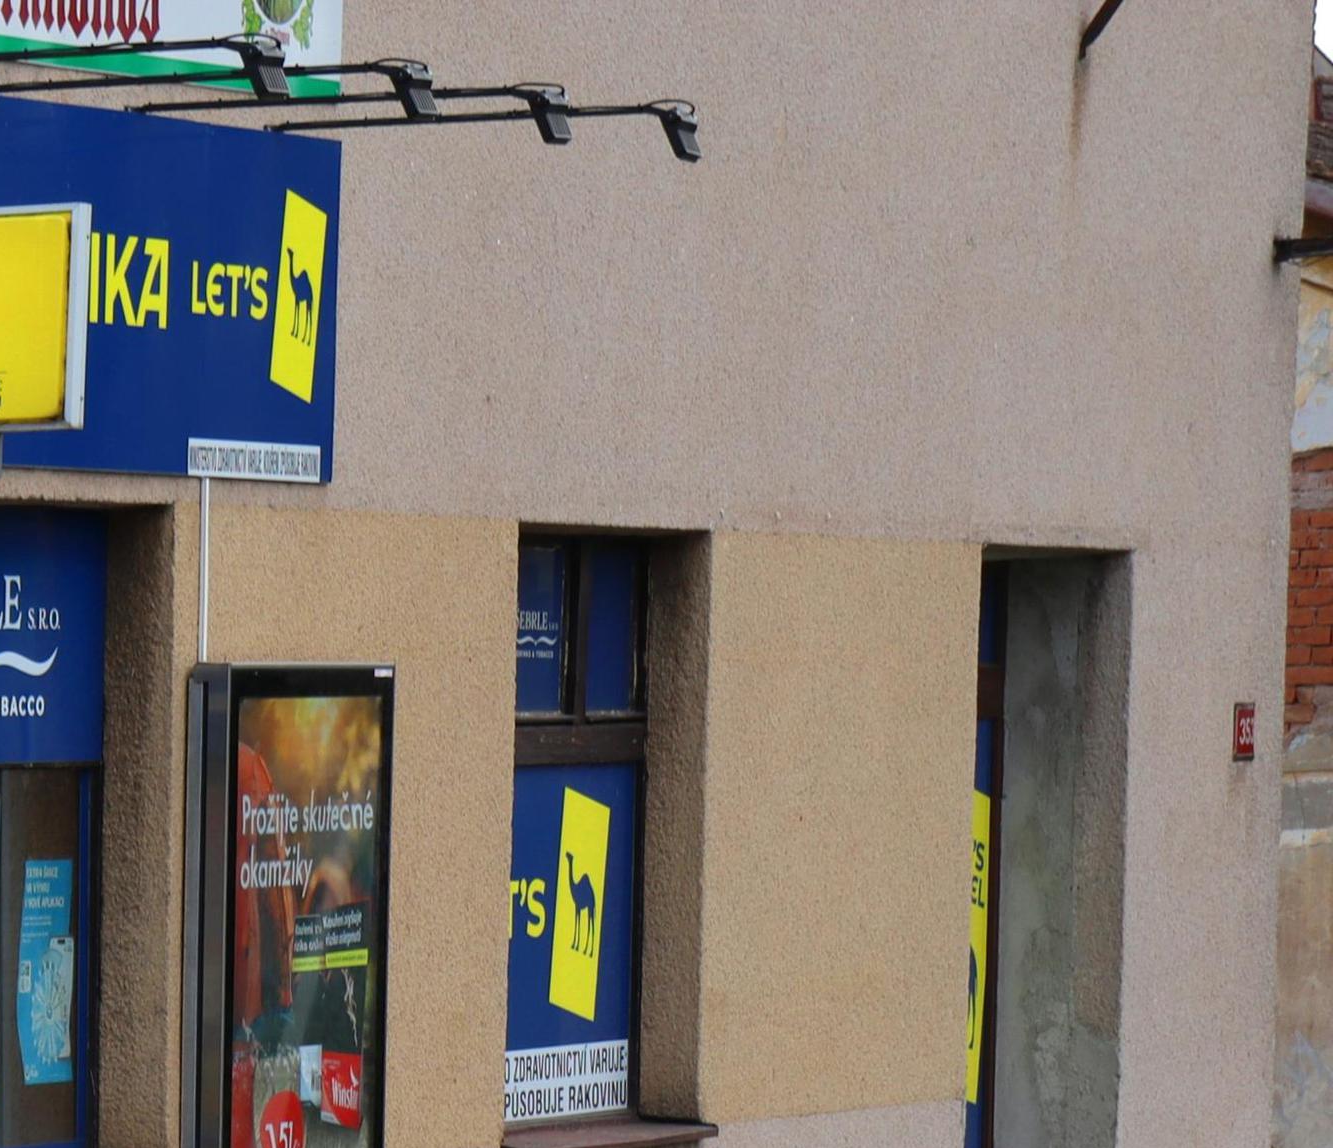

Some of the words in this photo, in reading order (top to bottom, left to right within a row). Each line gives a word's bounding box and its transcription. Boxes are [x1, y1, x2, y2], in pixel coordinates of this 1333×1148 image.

[191, 260, 269, 321] LET'S
[242, 793, 298, 845] Prožijte
[302, 789, 374, 833] skutečné
[240, 842, 314, 898] okamžiky
[514, 1045, 588, 1083] ZDRAVOTNICTVÍ
[505, 1085, 564, 1119] PŮSOBUJE
[568, 1079, 629, 1110] RAKOVINU
